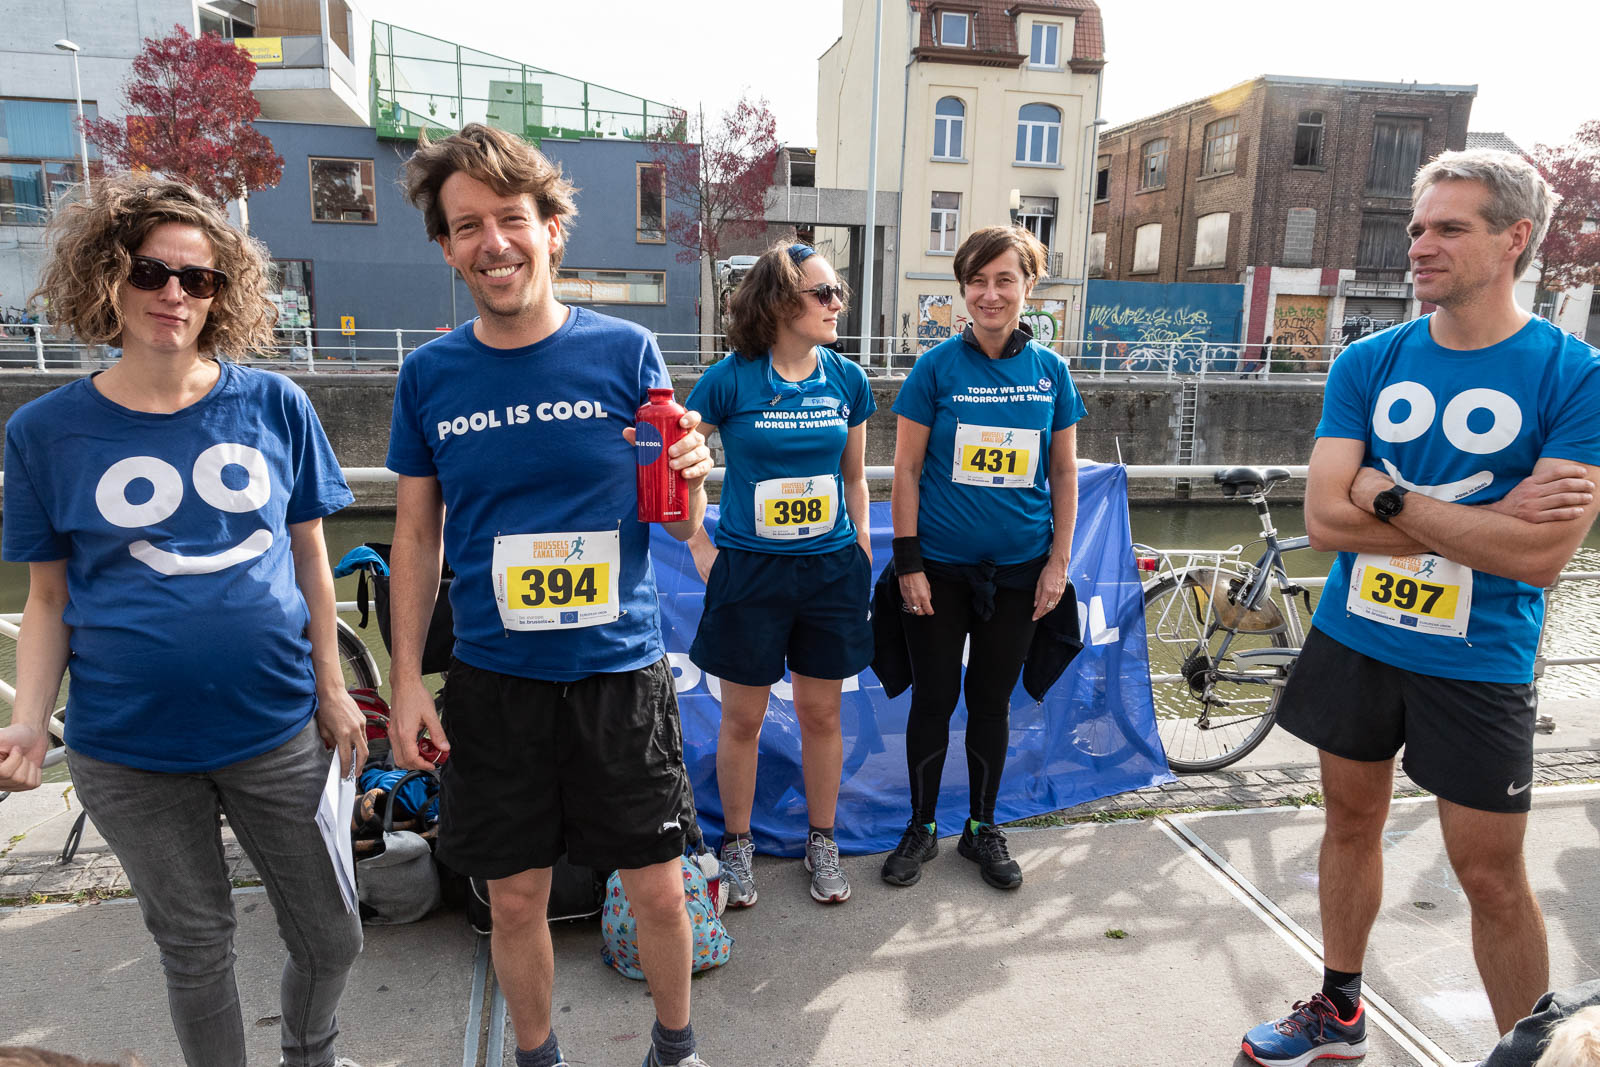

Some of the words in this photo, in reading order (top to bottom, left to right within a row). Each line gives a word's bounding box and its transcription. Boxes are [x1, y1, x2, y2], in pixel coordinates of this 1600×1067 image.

[967, 386, 998, 394] TODAY
[952, 395, 1008, 403] TOMORROW
[1010, 394, 1025, 402] WE
[1026, 394, 1052, 402] SWIM!
[437, 409, 501, 441] POOL
[506, 404, 531, 425] IS
[536, 400, 608, 422] COOL
[763, 411, 808, 420] VANDAAG
[755, 421, 797, 429] MORGEN
[970, 448, 1017, 473] 431
[773, 498, 822, 525] 398
[533, 540, 569, 551] BRUSSELS
[533, 549, 555, 559] CANAL
[555, 549, 569, 558] RUN
[520, 567, 598, 607] 394
[1371, 572, 1445, 614] 397
